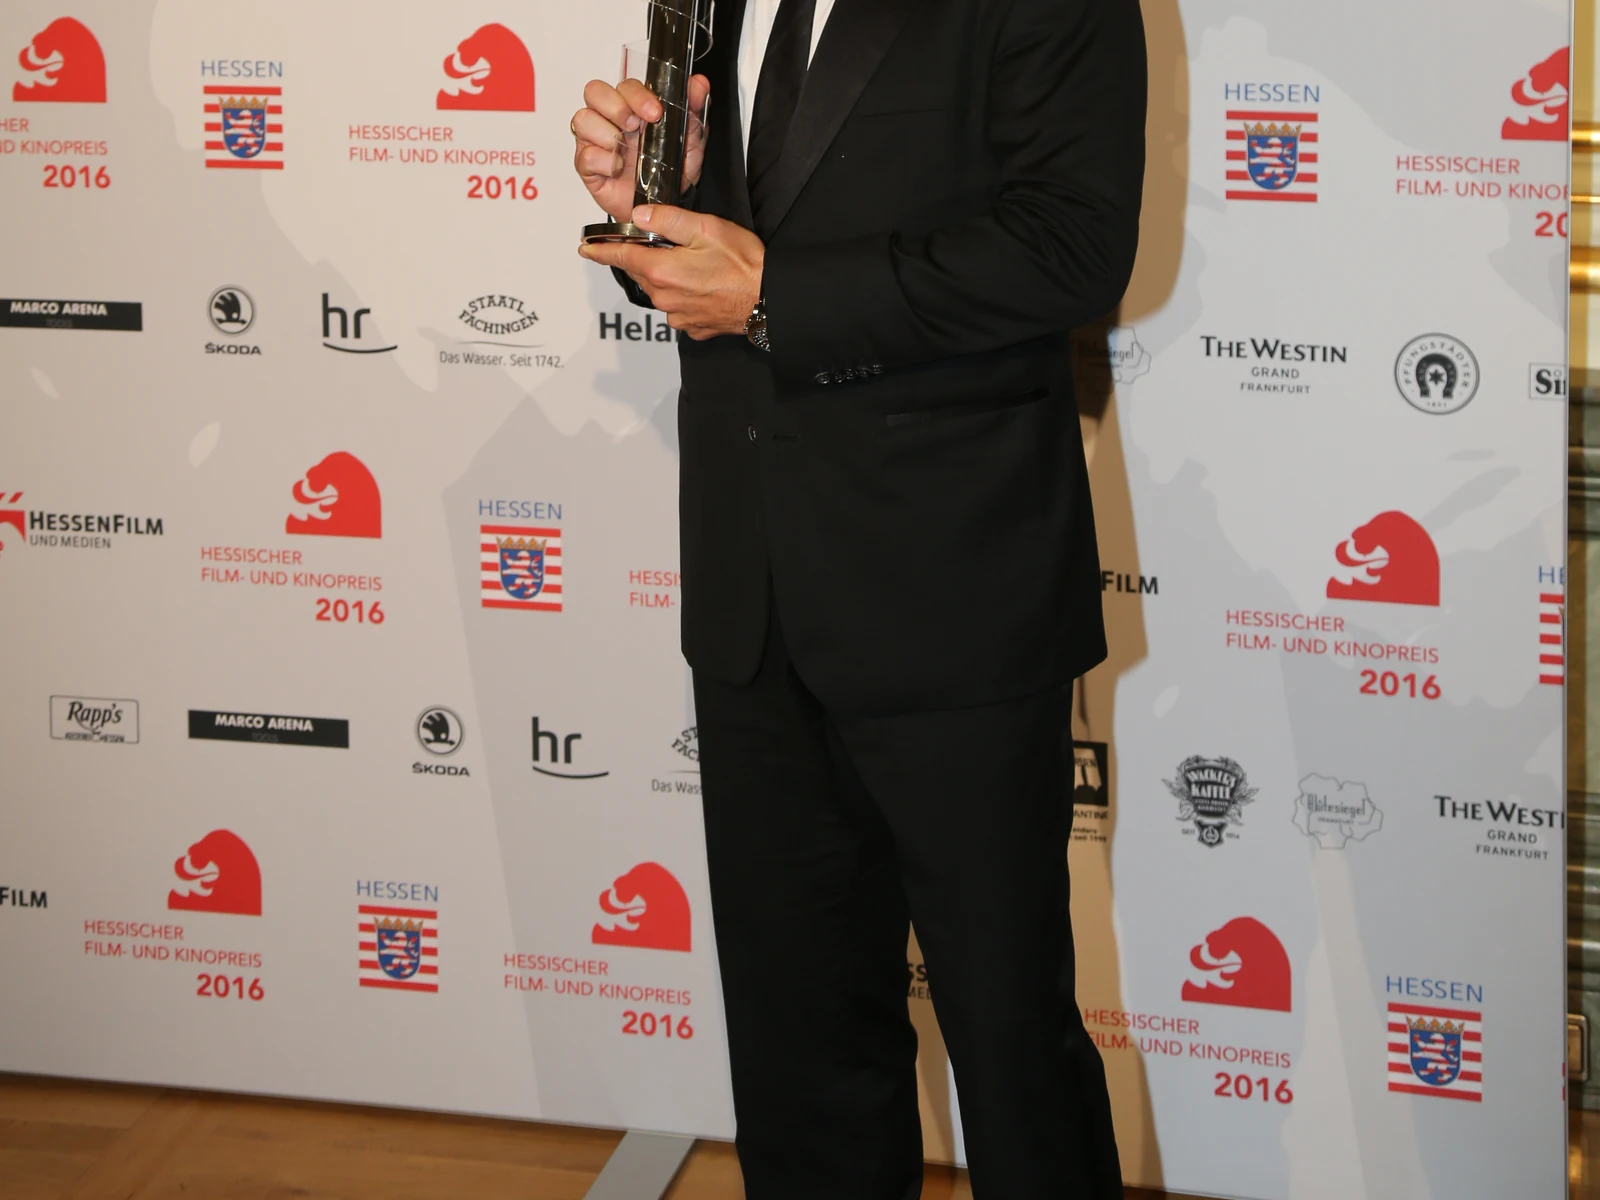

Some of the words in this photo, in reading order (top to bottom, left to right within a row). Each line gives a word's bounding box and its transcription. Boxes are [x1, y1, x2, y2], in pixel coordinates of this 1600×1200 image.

[201, 60, 282, 78] HESSEN
[1225, 83, 1319, 103] HESSEN
[349, 125, 453, 141] HESSISCHER
[21, 140, 108, 156] KINOPREIS
[349, 147, 393, 162] FILM-
[400, 148, 438, 163] UND
[444, 150, 535, 166] KINOPREIS
[1396, 156, 1520, 174] HESSISCHER
[43, 165, 111, 189] 2016
[467, 175, 538, 200] 2016
[1396, 179, 1448, 196] FILM-
[1456, 182, 1501, 197] UND
[10, 301, 59, 315] MARCO
[62, 303, 108, 316] ARENA
[322, 293, 370, 339] hr
[459, 309, 540, 335] FACHINGEN
[600, 312, 681, 343] Hela
[204, 342, 261, 356] ŠKODA
[439, 351, 460, 363] Das
[462, 352, 506, 366] Wasser.
[510, 354, 532, 367] Seit
[535, 355, 565, 369] 1742.
[1201, 336, 1247, 358] THE
[1251, 338, 1346, 362] WESTIN
[1251, 367, 1299, 379] GRAND
[1241, 382, 1310, 393] FRANKFURT
[479, 500, 562, 520] HESSEN
[61, 536, 111, 548] MEDIEN
[201, 546, 302, 564] HESSISCHER
[202, 567, 244, 582] FILM-
[250, 571, 288, 586] UND
[293, 573, 382, 591] KINOPREIS
[316, 598, 384, 624] 2016
[629, 593, 676, 608] FILM-
[1226, 610, 1344, 632] HESSISCHER
[1226, 633, 1276, 650] FILM-
[1284, 637, 1327, 654] UND
[1334, 641, 1439, 664] KINOPREIS
[1360, 669, 1441, 700] 2016
[67, 701, 122, 730] Rapp's
[215, 714, 264, 728] MARCO
[268, 717, 314, 732] ARENA
[532, 717, 581, 764] hr
[411, 762, 470, 777] ŠKODA
[651, 778, 672, 792] Das
[1434, 796, 1483, 820] THE
[1487, 829, 1537, 843] GRAND
[1476, 844, 1548, 860] FRANKFURT
[357, 880, 438, 902] HESSEN
[84, 920, 183, 940] HESSISCHER
[85, 940, 126, 956] FILM-
[133, 945, 170, 960] UND
[175, 948, 262, 968] KINOPREIS
[504, 953, 608, 975] HESSISCHER
[197, 973, 264, 1001] 2016
[504, 974, 548, 991] FILM-
[554, 980, 593, 996] UND
[599, 983, 691, 1006] KINOPREIS
[1386, 976, 1482, 1003] HESSEN
[622, 1010, 693, 1039] 2016
[1084, 1008, 1200, 1035] HESSISCHER
[1140, 1038, 1183, 1057] UND
[1189, 1043, 1291, 1068] KINOPREIS
[1214, 1072, 1293, 1104] 2016
